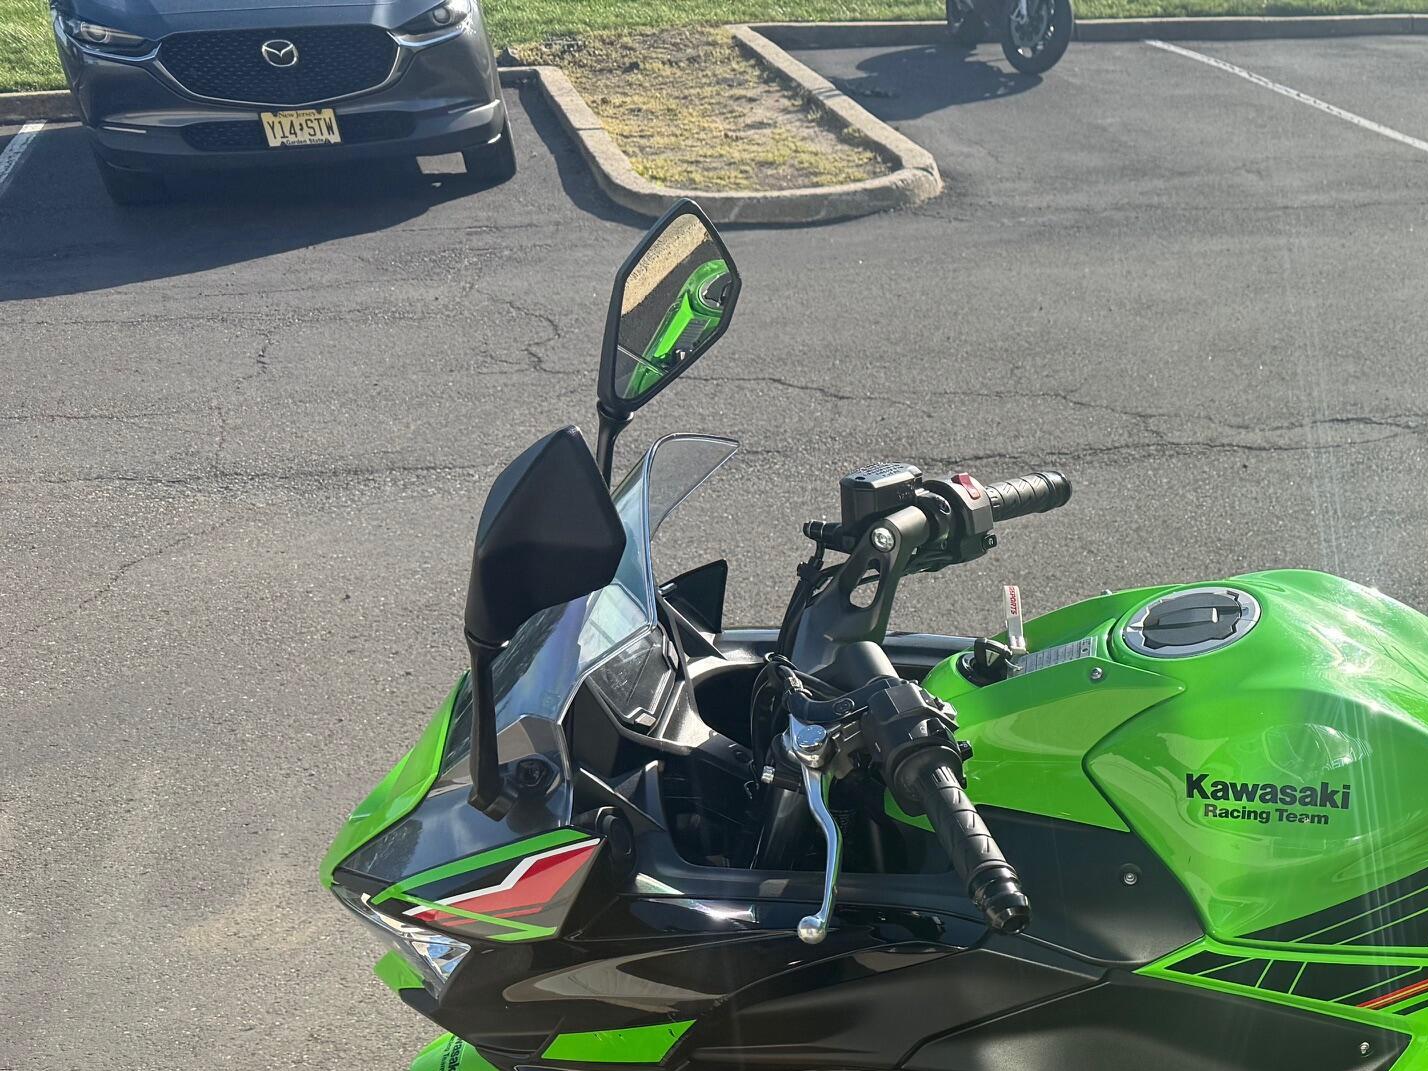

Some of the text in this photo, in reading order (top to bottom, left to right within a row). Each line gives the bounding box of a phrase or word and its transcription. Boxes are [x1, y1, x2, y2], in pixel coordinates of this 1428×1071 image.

[1185, 773, 1351, 810] Kawasaki
[1203, 803, 1329, 825] Racing Team
